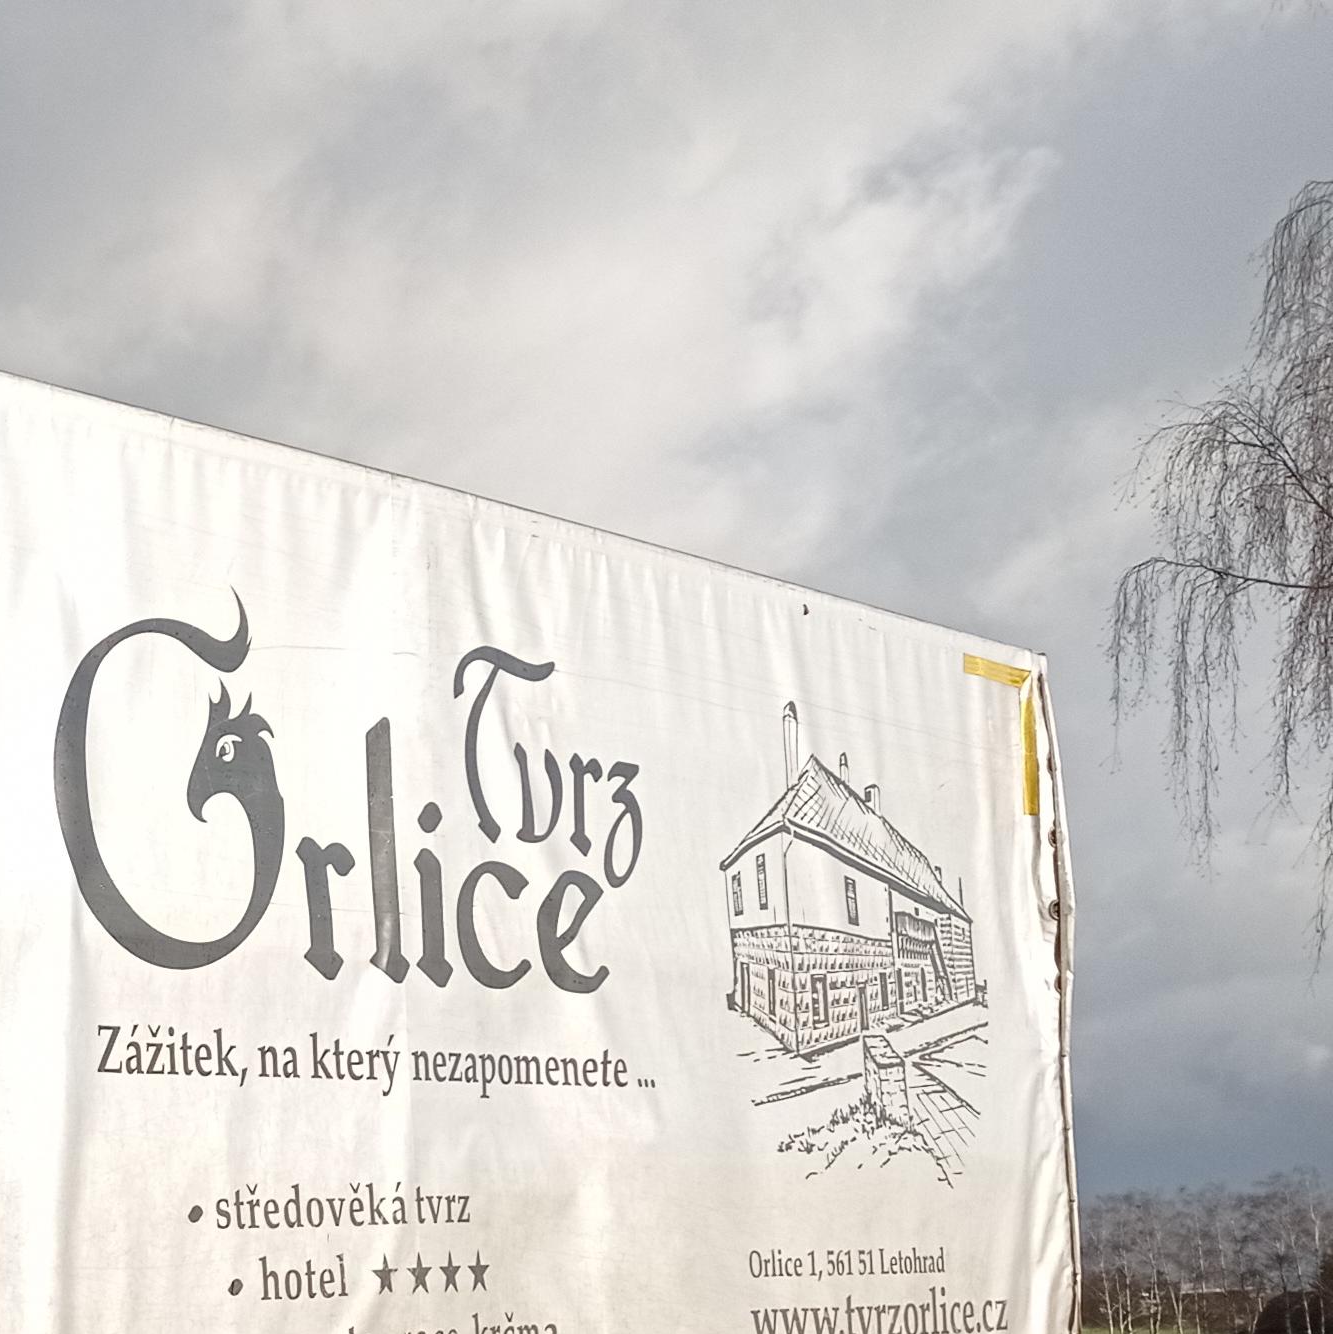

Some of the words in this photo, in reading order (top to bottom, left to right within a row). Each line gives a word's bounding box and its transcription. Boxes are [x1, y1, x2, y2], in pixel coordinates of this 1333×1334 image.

[453, 645, 643, 888] Tvrz
[97, 1024, 248, 1087] Zážitek,
[258, 1044, 301, 1079] na
[310, 1033, 401, 1096] který
[215, 1183, 408, 1229] středověká
[415, 1186, 471, 1225] tvrz
[259, 1252, 349, 1301] hotel
[749, 1249, 803, 1278] Orlice
[807, 1251, 823, 1282] 1,
[827, 1249, 854, 1276] 561
[858, 1249, 876, 1276] 51
[879, 1247, 946, 1275] Letohrad
